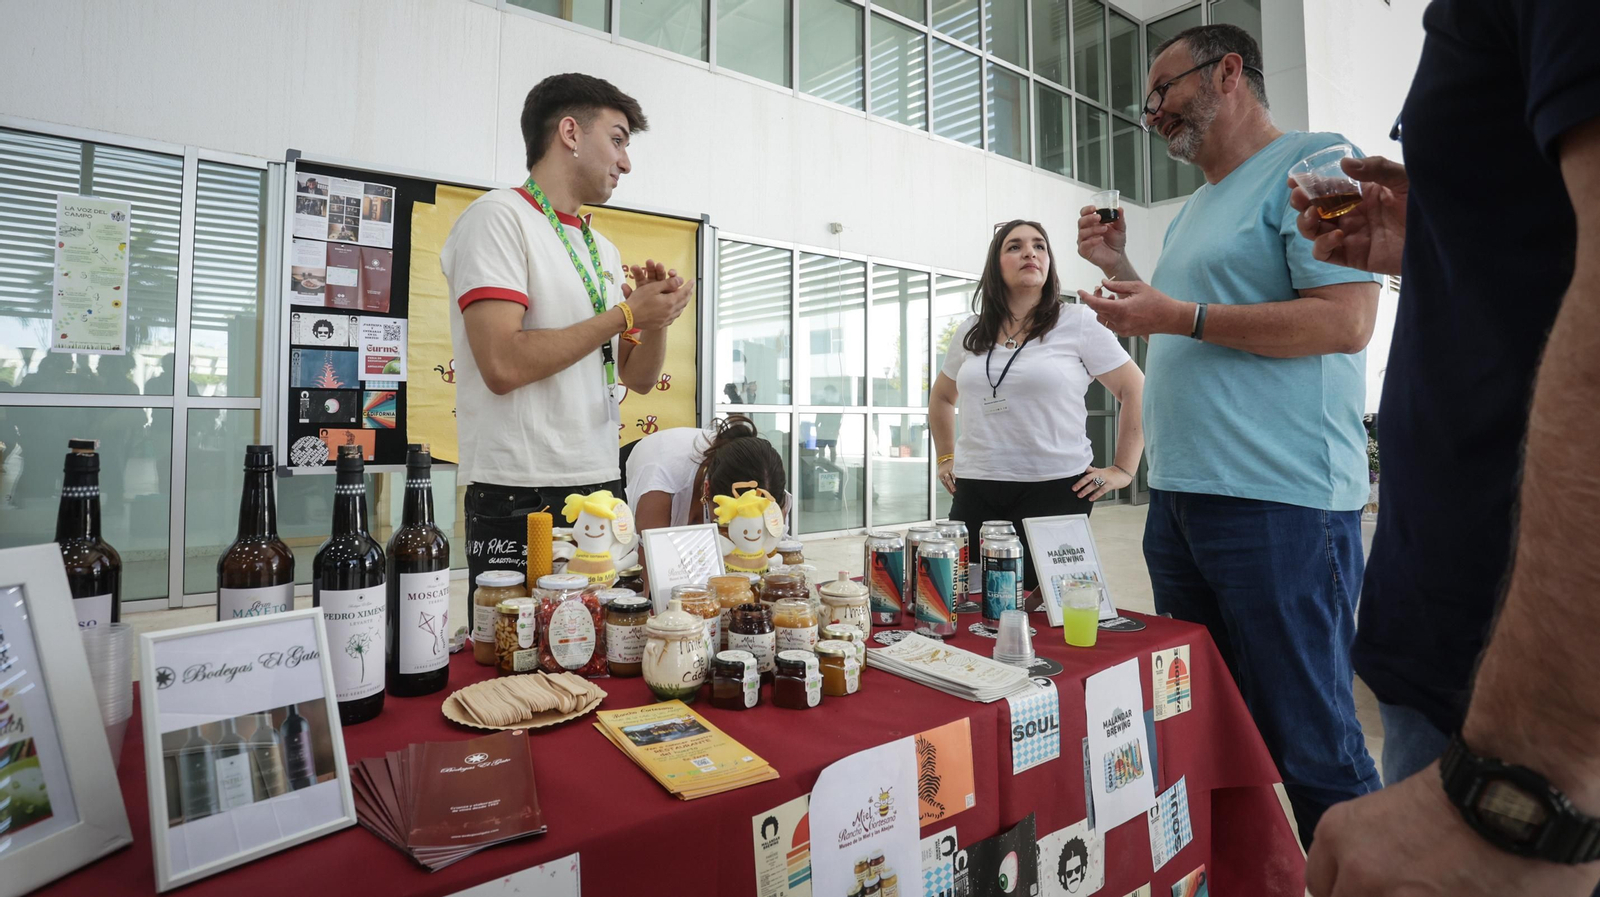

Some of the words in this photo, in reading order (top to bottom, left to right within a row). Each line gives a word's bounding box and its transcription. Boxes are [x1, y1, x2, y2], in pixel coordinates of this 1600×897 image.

[64, 211, 93, 219] CAMPO
[487, 538, 517, 554] RACE
[1047, 548, 1085, 557] MALANDAR
[1052, 555, 1084, 565] BREWING
[232, 604, 287, 618] MAYETO
[324, 612, 355, 620] PEDRO
[357, 604, 386, 618] XIMÉNE
[182, 662, 253, 684] Bodegas
[258, 652, 282, 669] El
[285, 645, 320, 668] Gato
[1013, 714, 1058, 742] SOUL
[1102, 709, 1132, 730] MALANDAR
[1106, 719, 1131, 738] BREWING
[838, 828, 862, 842] Rancho
[869, 815, 896, 830] Cortesano
[852, 806, 873, 832] Miel
[1170, 785, 1182, 852] SOUL
[839, 840, 852, 849] Museo
[881, 824, 894, 832] Abejas
